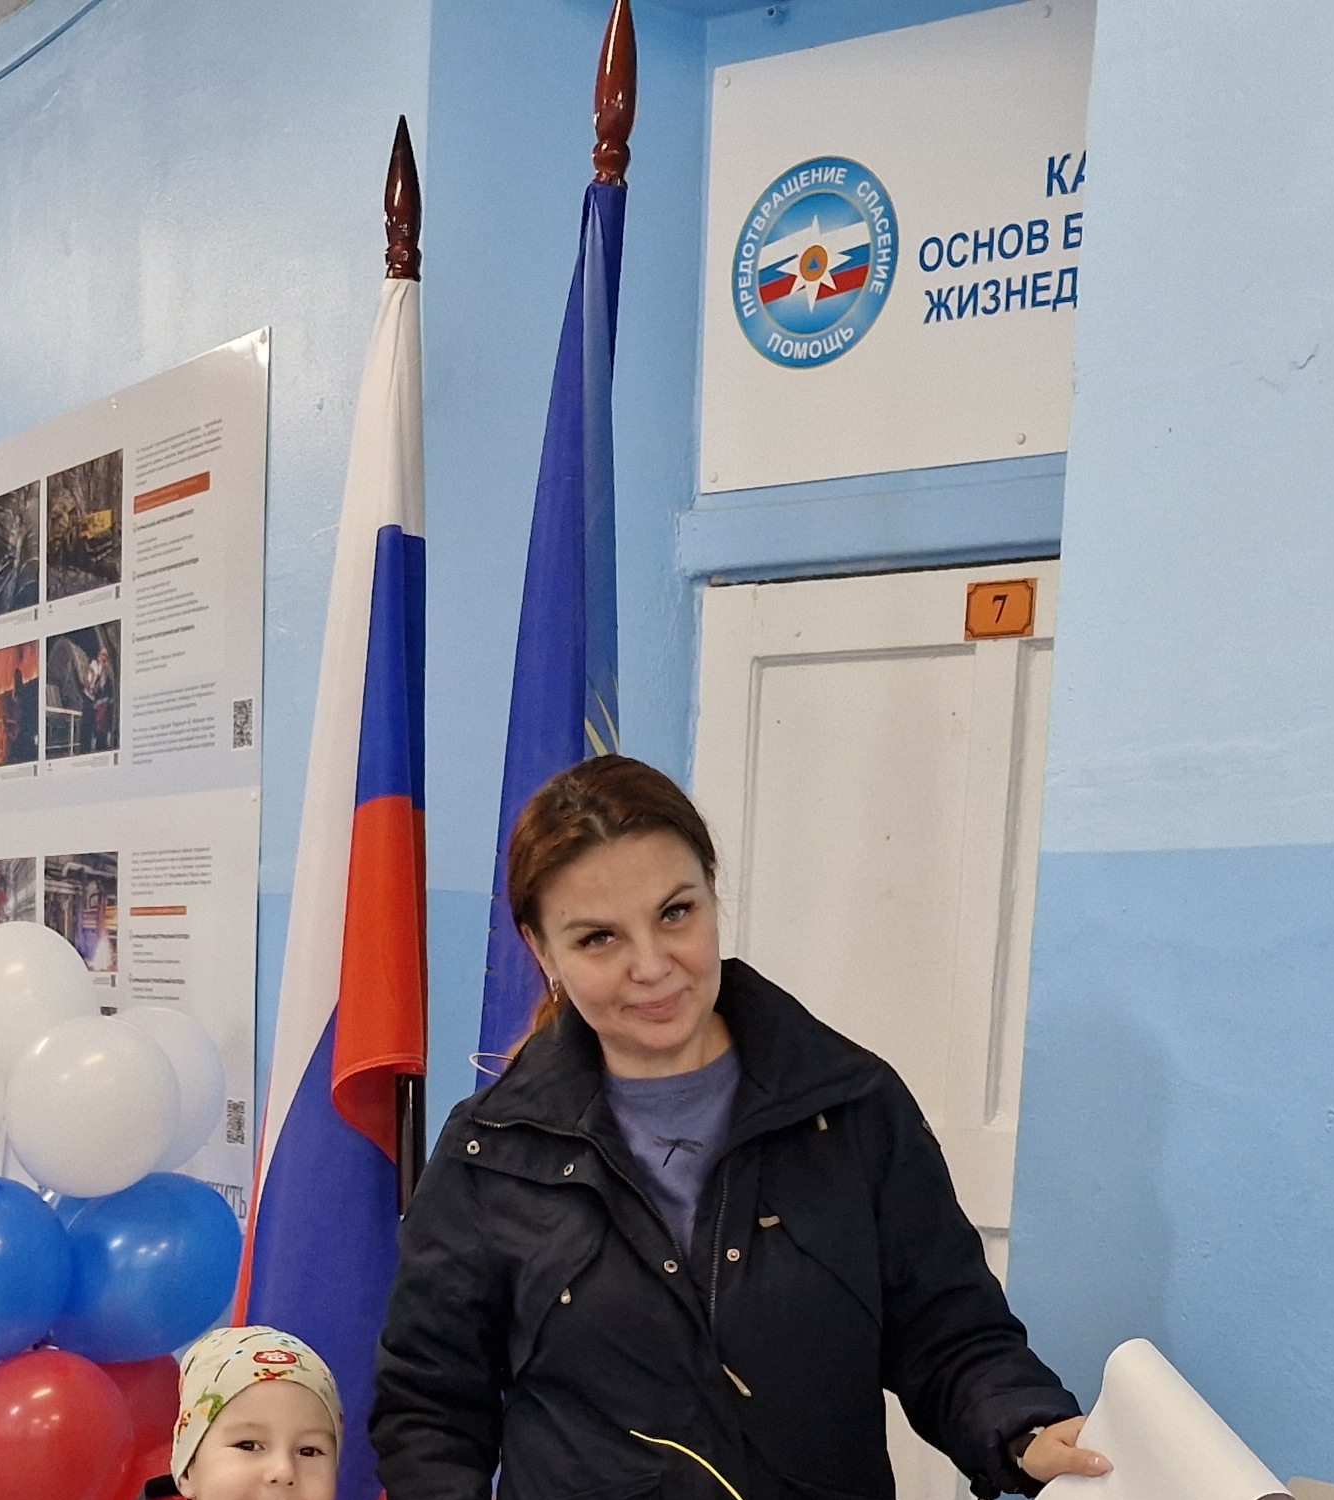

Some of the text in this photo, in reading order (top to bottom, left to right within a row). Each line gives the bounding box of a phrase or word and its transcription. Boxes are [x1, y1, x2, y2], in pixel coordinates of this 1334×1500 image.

[738, 166, 848, 319] ПРЕДОТВРАЩЕНИЕ
[856, 181, 892, 295] СПАСЕНИЕ
[919, 212, 1083, 272] ОСНОВ Б
[923, 267, 1078, 324] ЖИЗНЕД
[766, 326, 855, 360] ПОМОЩЬ
[991, 594, 1008, 625] 7
